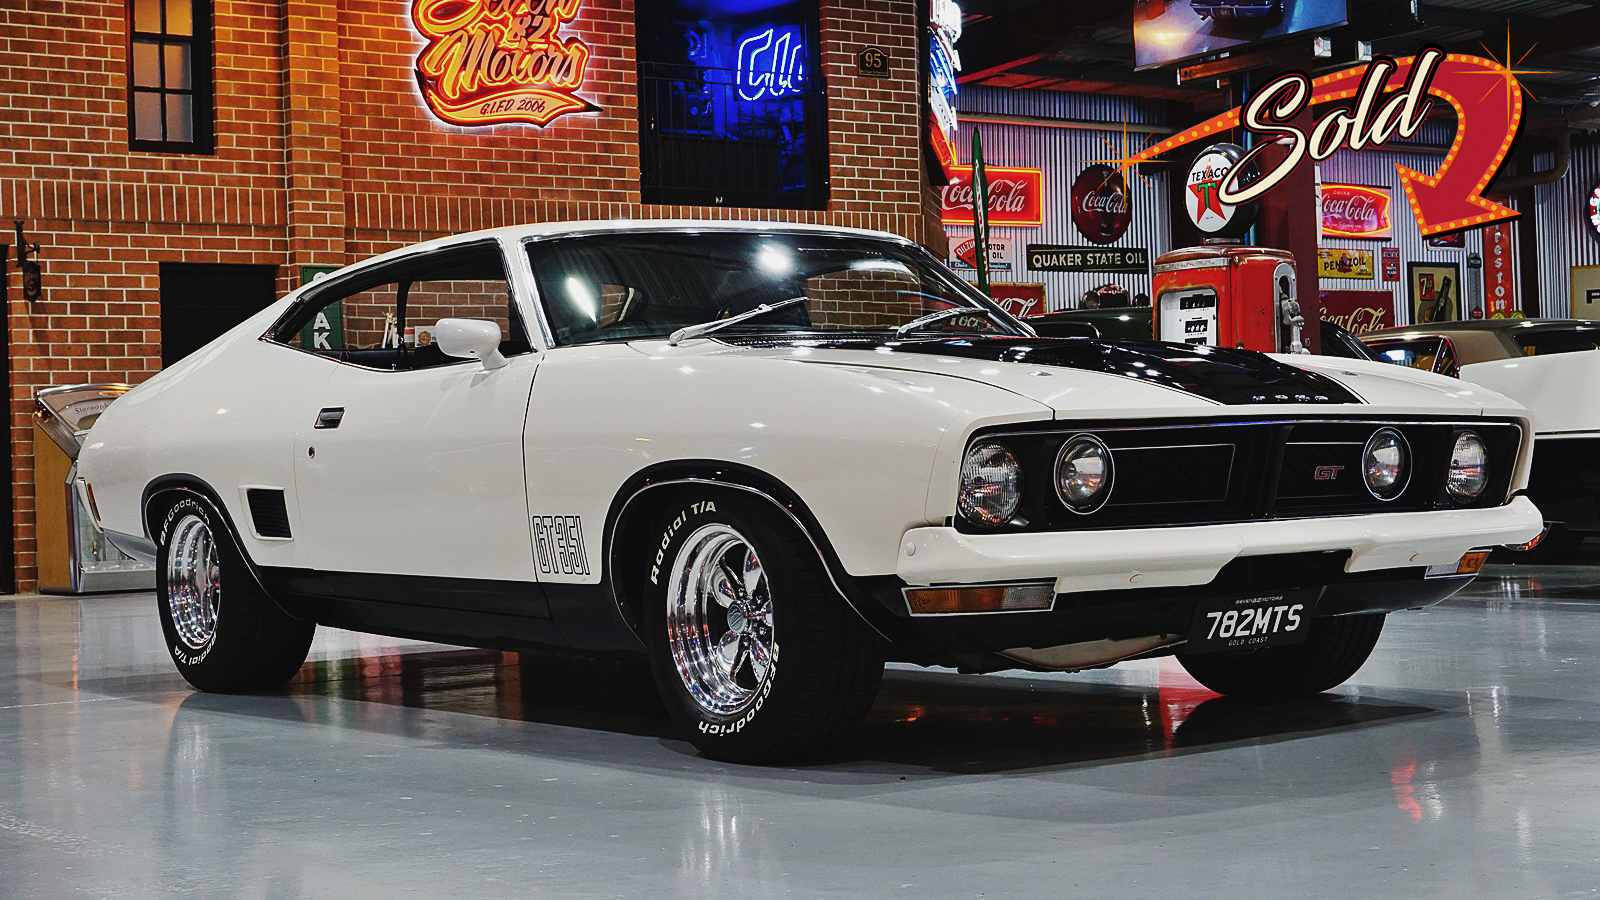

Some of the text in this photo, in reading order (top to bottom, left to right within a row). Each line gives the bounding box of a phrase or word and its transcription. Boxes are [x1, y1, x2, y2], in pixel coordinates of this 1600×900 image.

[508, 15, 551, 43] 82
[427, 29, 583, 96] Motors
[865, 53, 881, 68] 95
[517, 99, 546, 113] 2006
[1192, 167, 1228, 182] TEXACO
[988, 243, 1005, 251] OTOR
[1032, 252, 1146, 267] QUAKER STATE OIL
[1324, 257, 1366, 271] PENNZOIL
[1314, 465, 1345, 480] GT
[160, 498, 210, 546] BFGoodrich
[650, 501, 717, 585] Radial T/A
[1206, 603, 1304, 640] 782MTS
[1248, 636, 1268, 645] COAST
[698, 641, 780, 737] BFGoodrich
